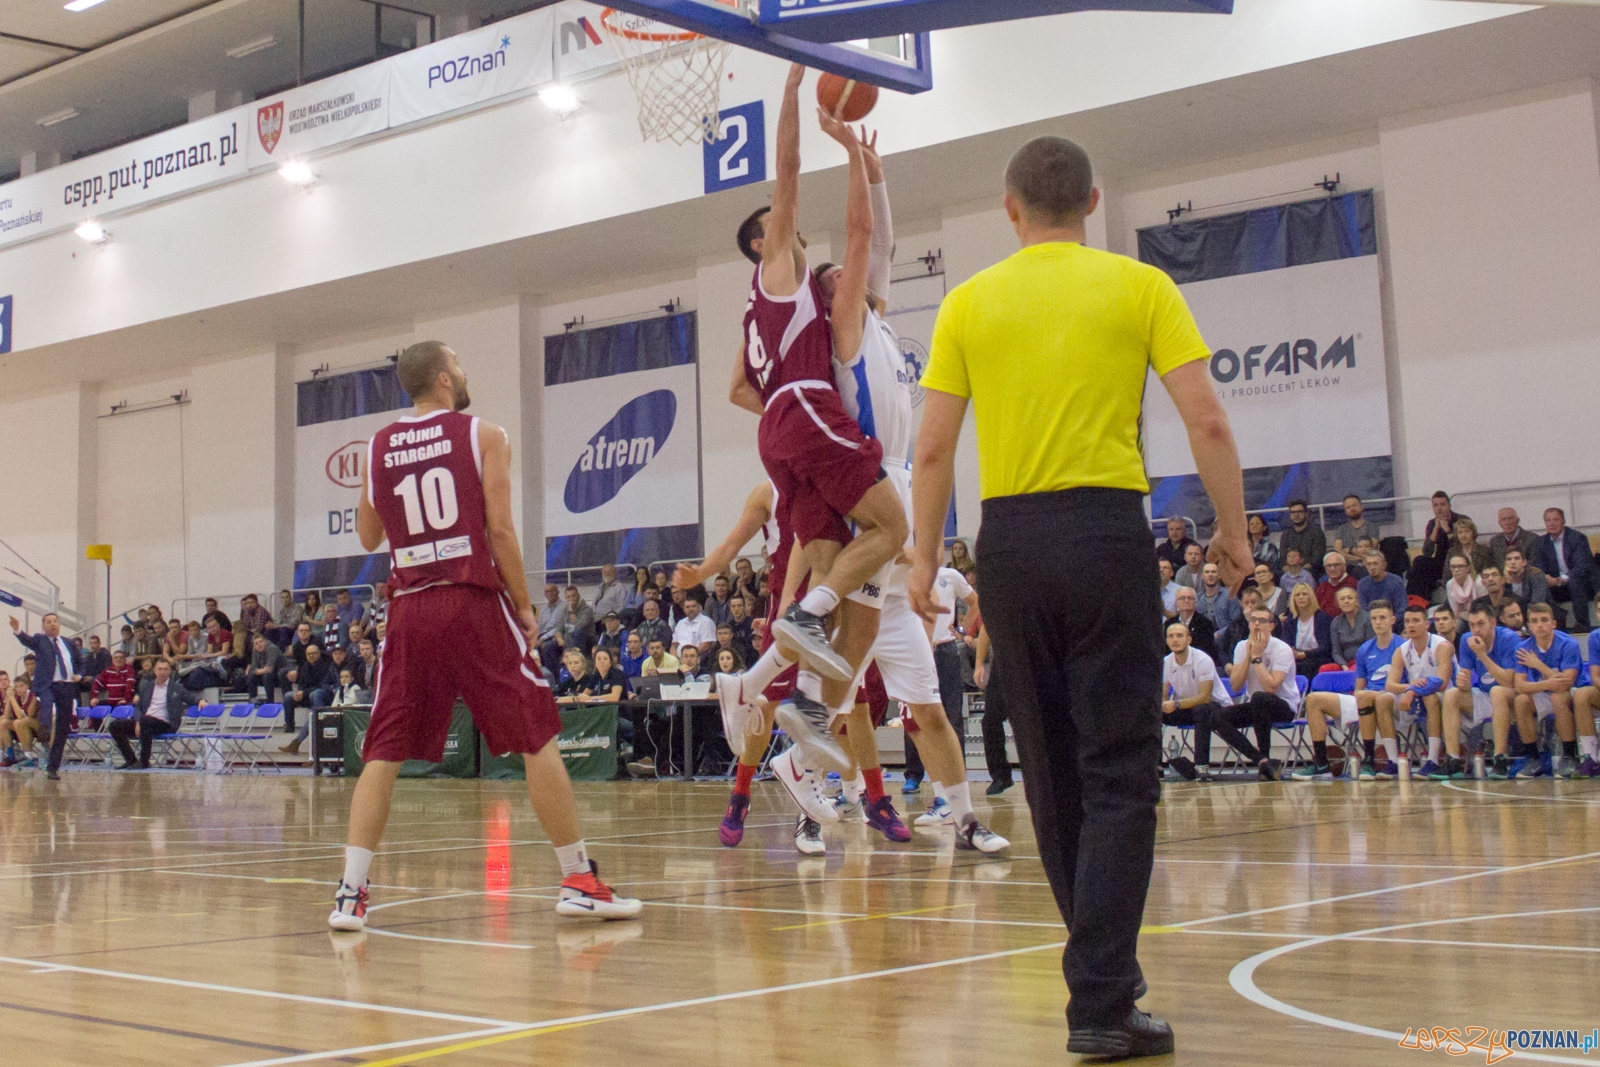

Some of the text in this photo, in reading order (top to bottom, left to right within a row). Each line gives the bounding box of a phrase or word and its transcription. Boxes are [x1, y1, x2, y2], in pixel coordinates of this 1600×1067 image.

[64, 122, 237, 207] cspp.put.poznan.pl
[719, 115, 749, 181] 2
[1207, 334, 1356, 384] OFARM
[1232, 382, 1296, 397] PRODUCENT
[1301, 375, 1341, 389] LEKÓW
[384, 439, 452, 468] STARGARD
[389, 424, 443, 447] SPÓJNIA
[338, 452, 362, 479] KI
[580, 436, 655, 472] atrem
[393, 467, 459, 535] 10
